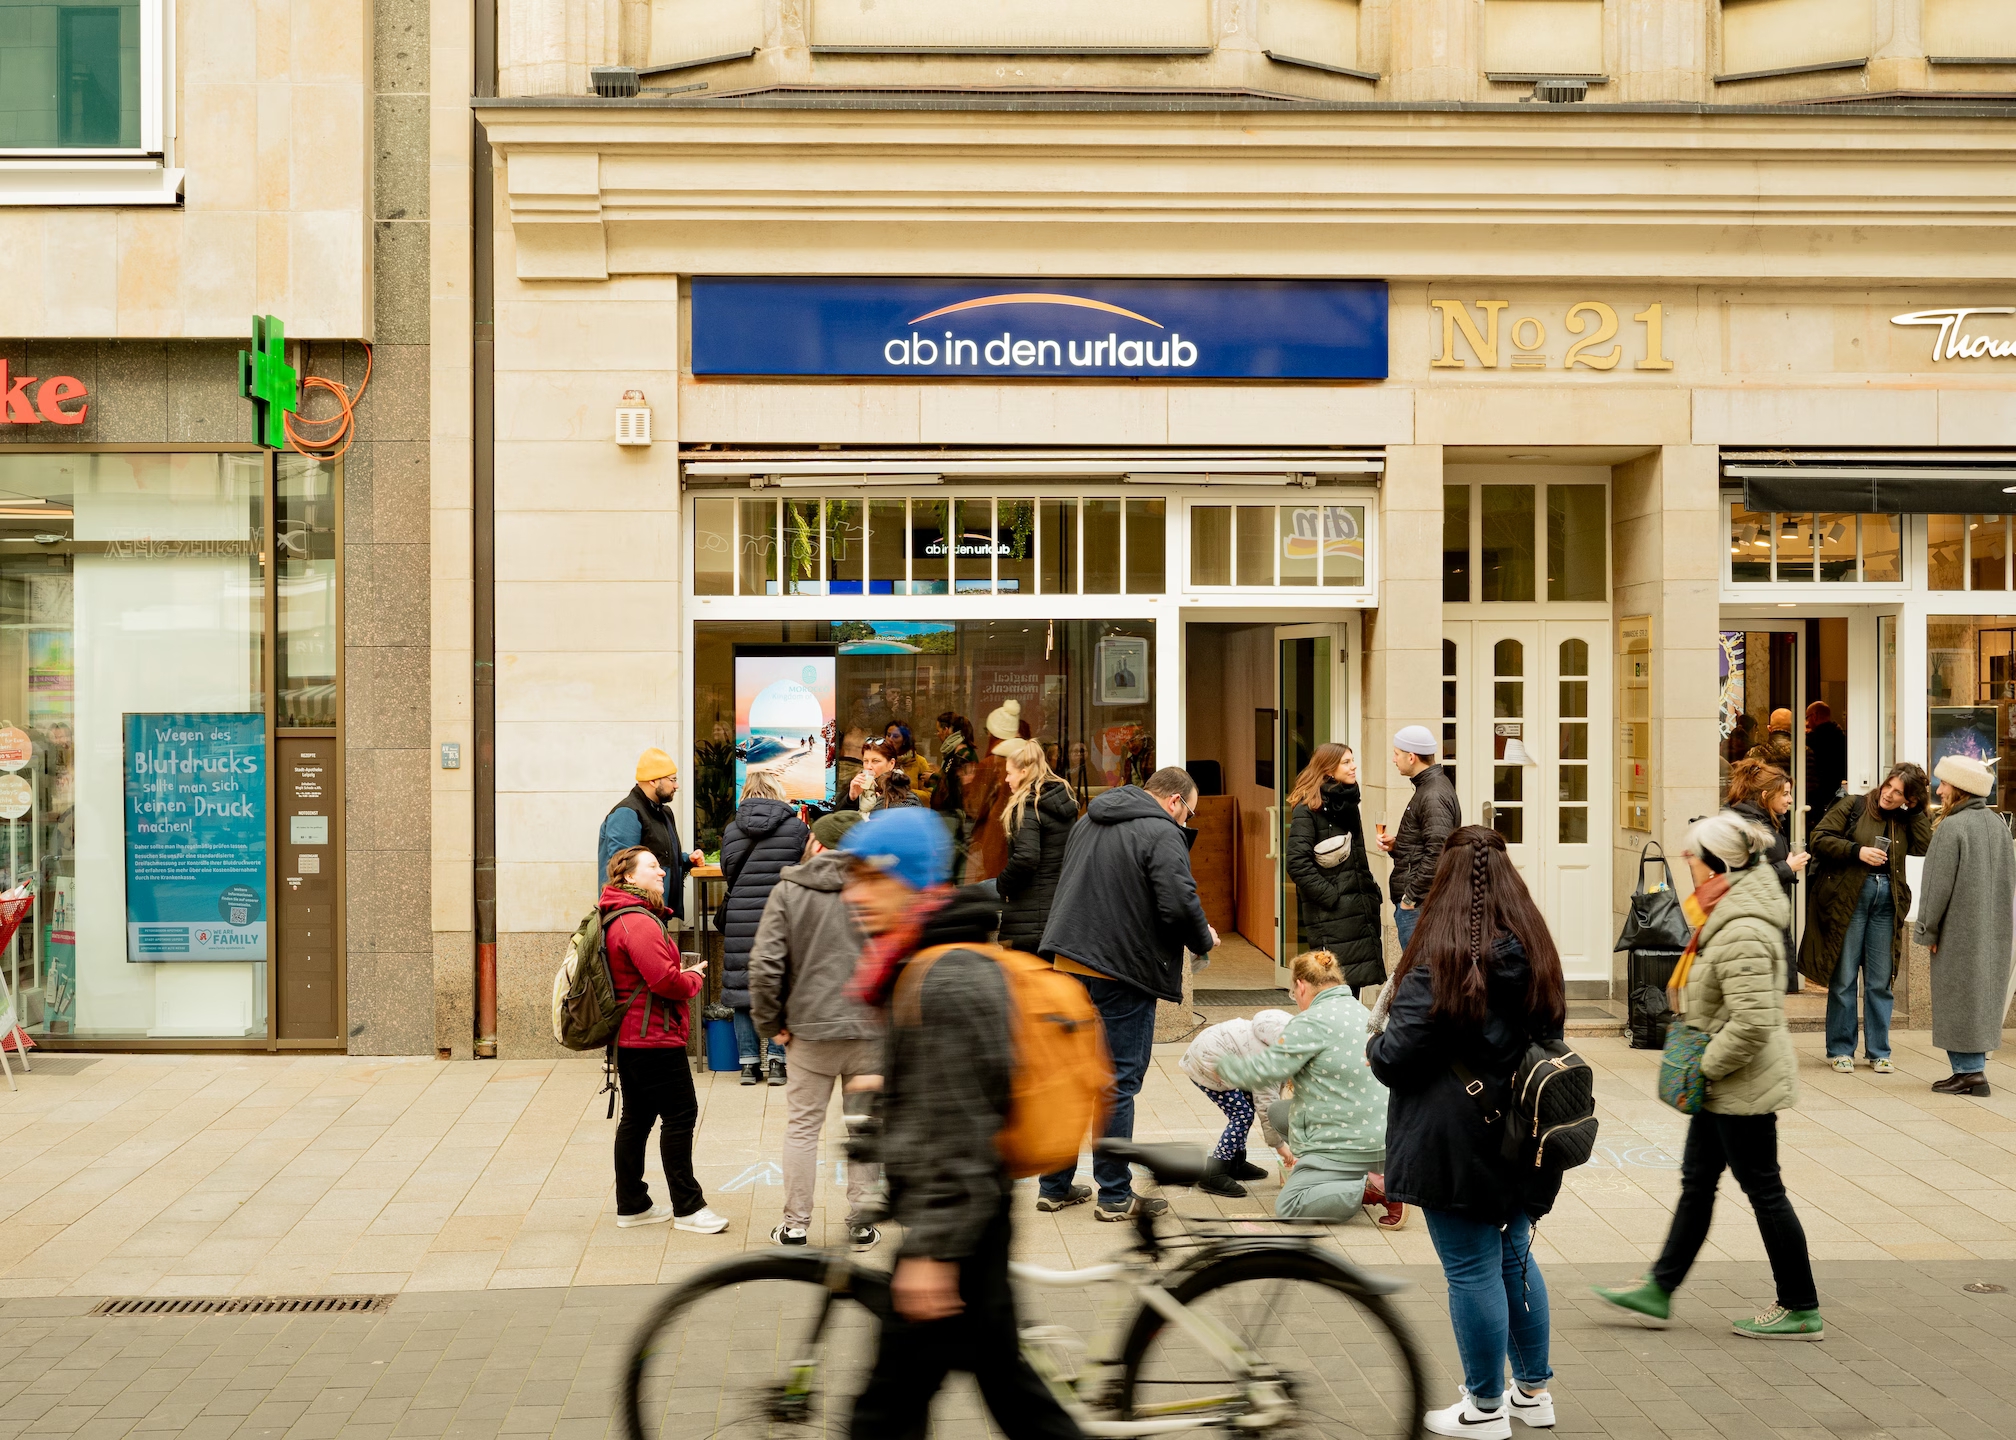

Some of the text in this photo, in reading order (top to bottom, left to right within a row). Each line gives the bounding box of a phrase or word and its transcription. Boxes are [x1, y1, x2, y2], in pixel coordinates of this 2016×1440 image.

[1564, 301, 1674, 370] 21
[885, 331, 1198, 367] ab in den urlaub
[925, 544, 941, 555] ab
[788, 685, 830, 693] MOROCCO
[155, 726, 231, 746] Wegen des
[135, 748, 258, 775] Blutdrucks
[143, 775, 239, 793] sollte man sich
[134, 793, 254, 818] keinen Druck
[137, 816, 192, 833] machen!
[213, 934, 259, 945] FAMILY
